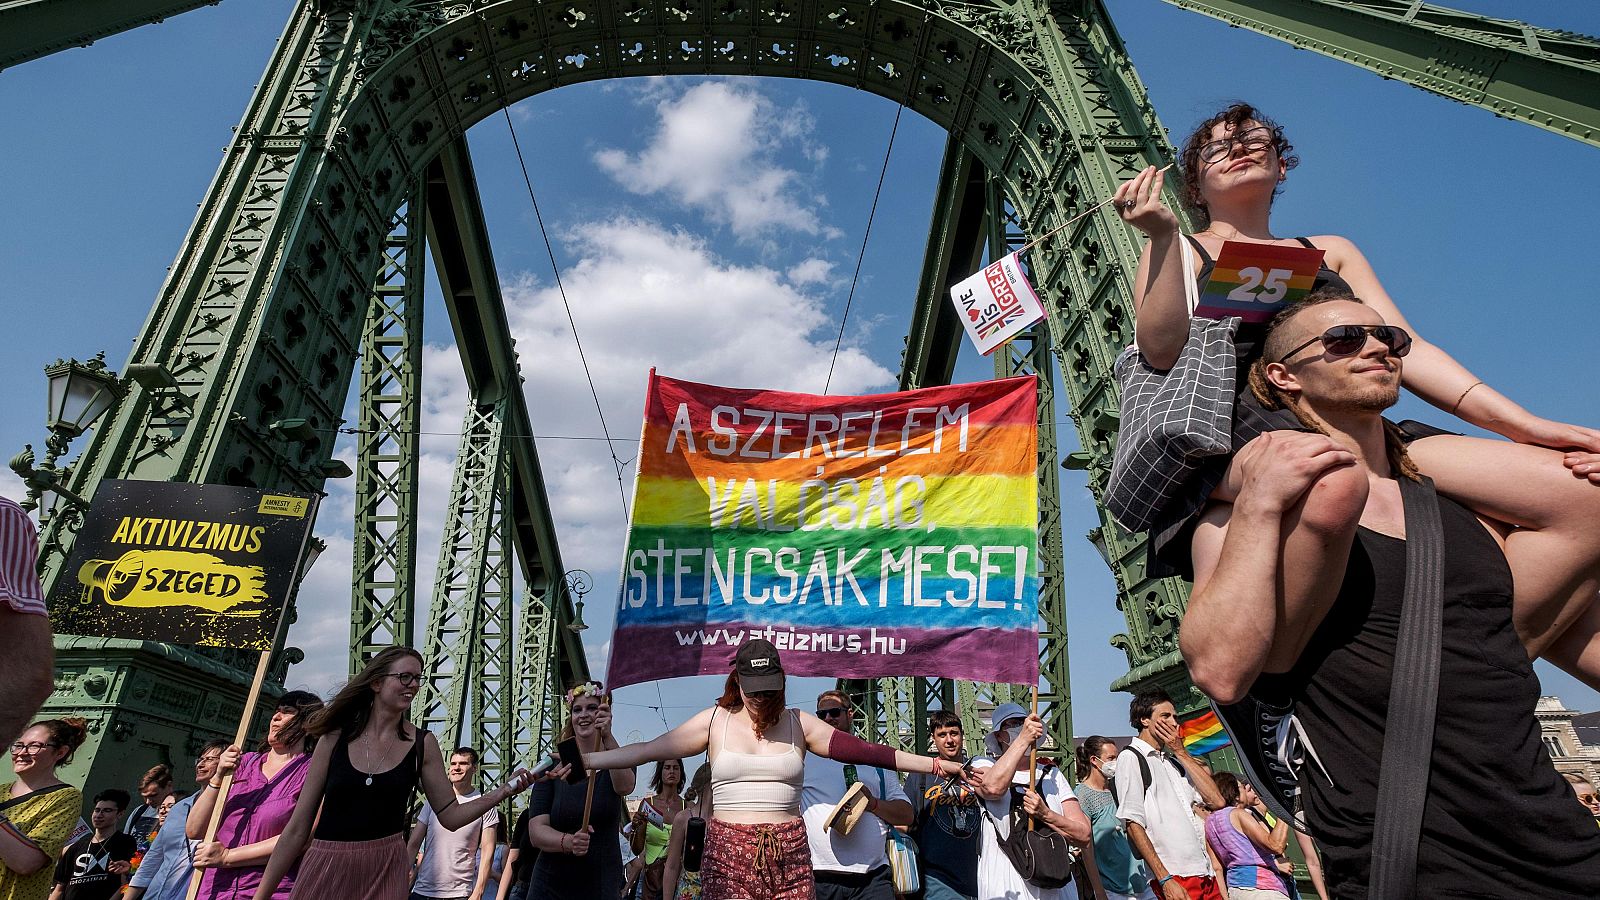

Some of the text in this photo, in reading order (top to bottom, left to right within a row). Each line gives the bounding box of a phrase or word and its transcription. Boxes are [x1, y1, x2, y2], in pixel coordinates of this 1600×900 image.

[1226, 266, 1293, 304] 25
[960, 288, 987, 329] LVE
[984, 304, 1000, 321] IS
[666, 402, 970, 459] A SZERELEM
[265, 499, 290, 507] AMNESTY
[707, 466, 936, 533] VALÓSÁG,
[111, 516, 265, 553] AKTIVIZMUS
[141, 568, 241, 598] SZEGED
[743, 547, 872, 607] CSAK
[879, 544, 1028, 610] MESE!
